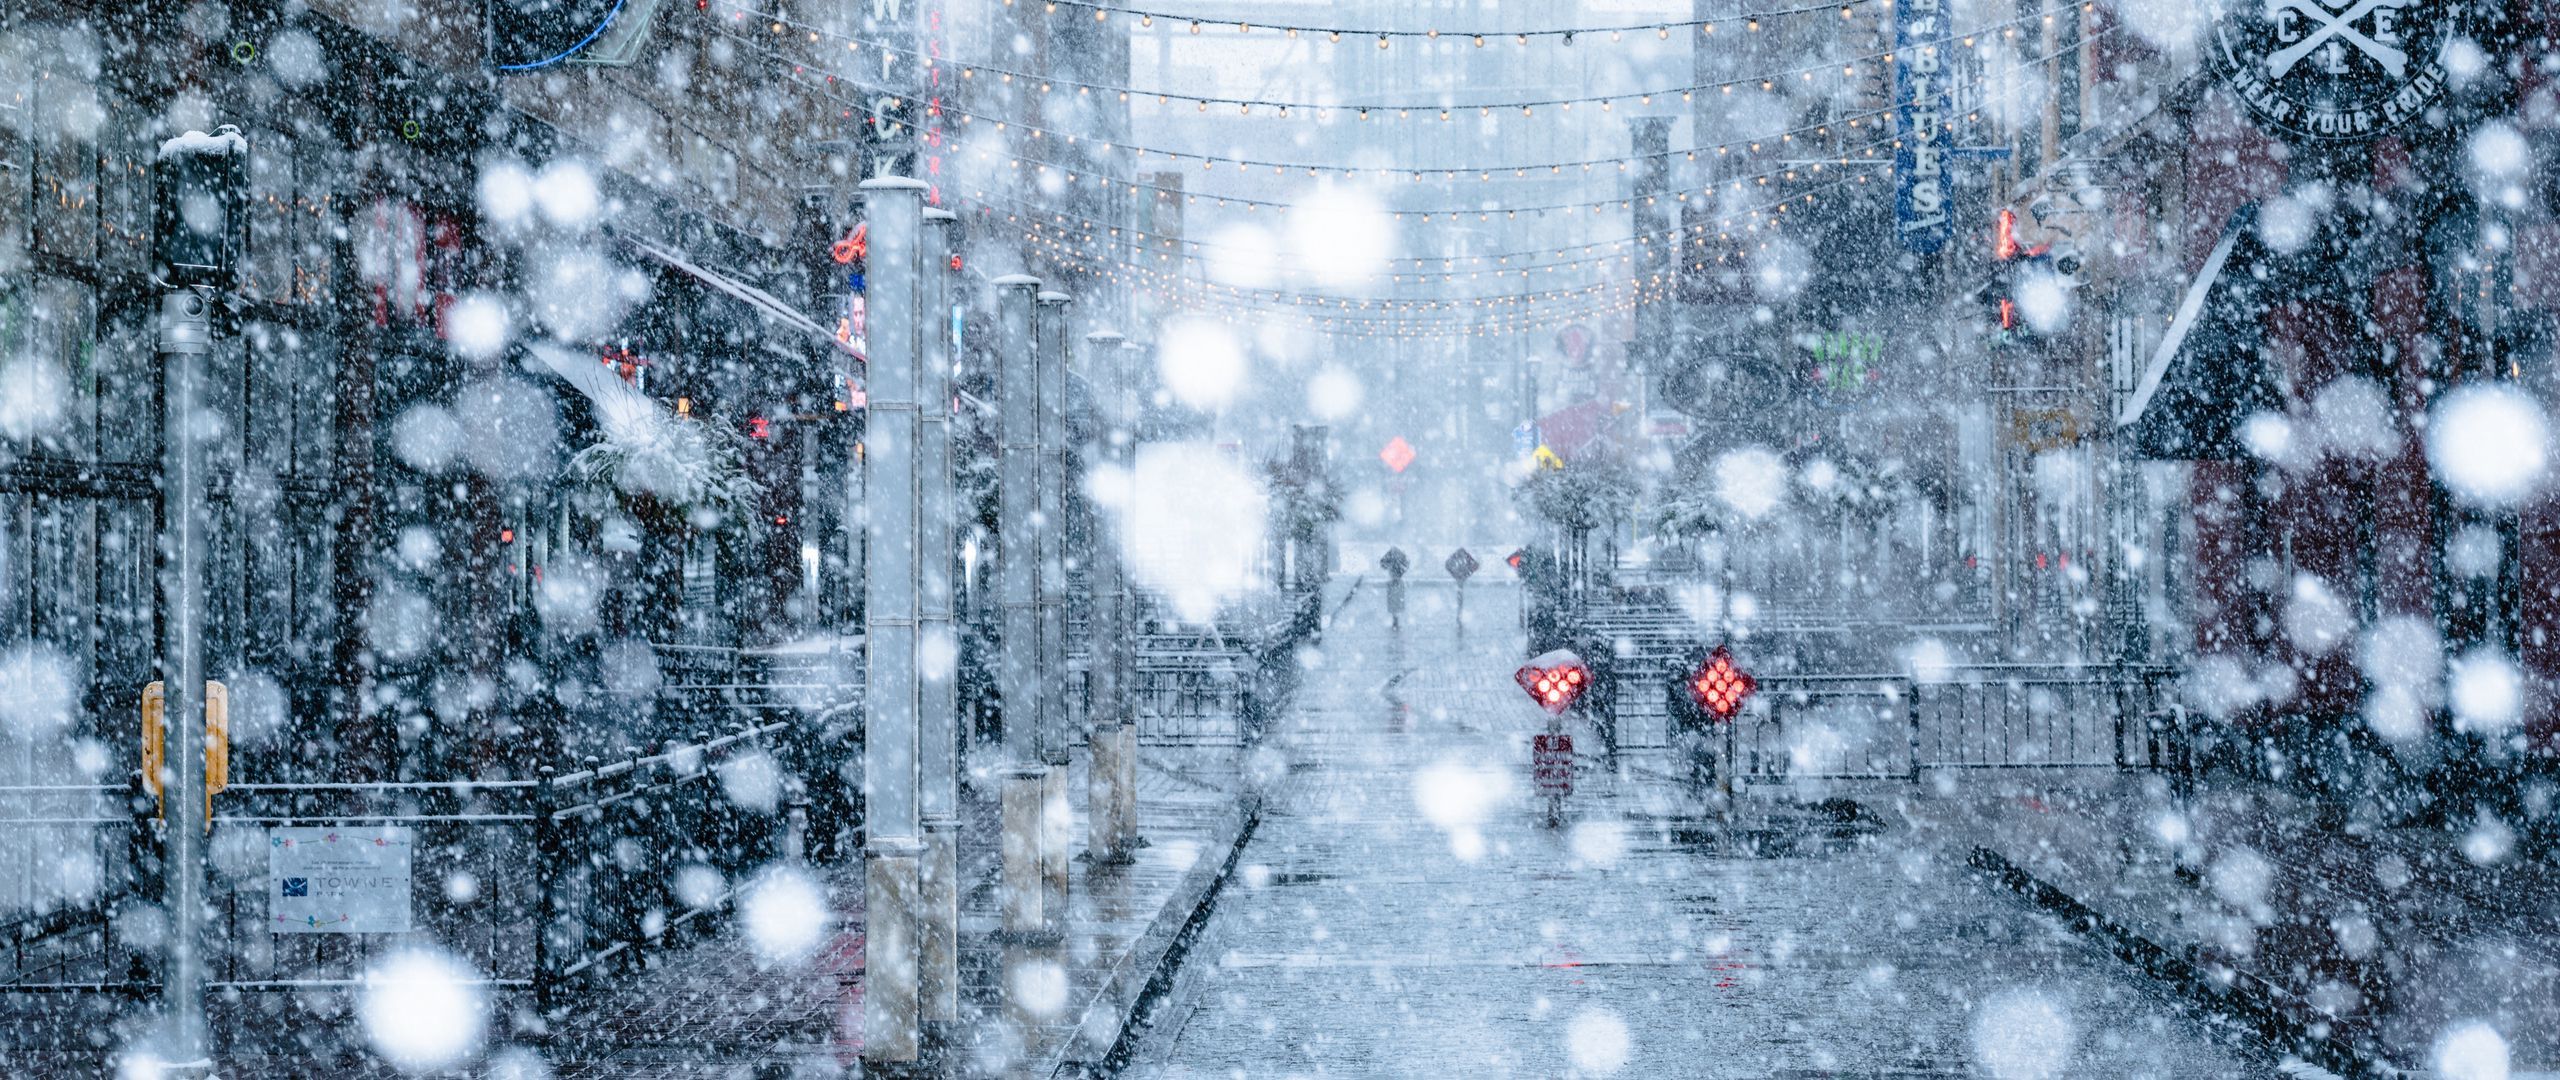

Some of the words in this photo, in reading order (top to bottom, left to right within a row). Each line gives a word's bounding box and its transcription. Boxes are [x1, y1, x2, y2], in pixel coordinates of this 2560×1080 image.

[1910, 46, 1941, 212] BLUES
[2232, 67, 2291, 122] WEAR
[2306, 110, 2371, 134] YOUR
[2383, 63, 2447, 123] PRIDE
[314, 876, 393, 888] TOWNE
